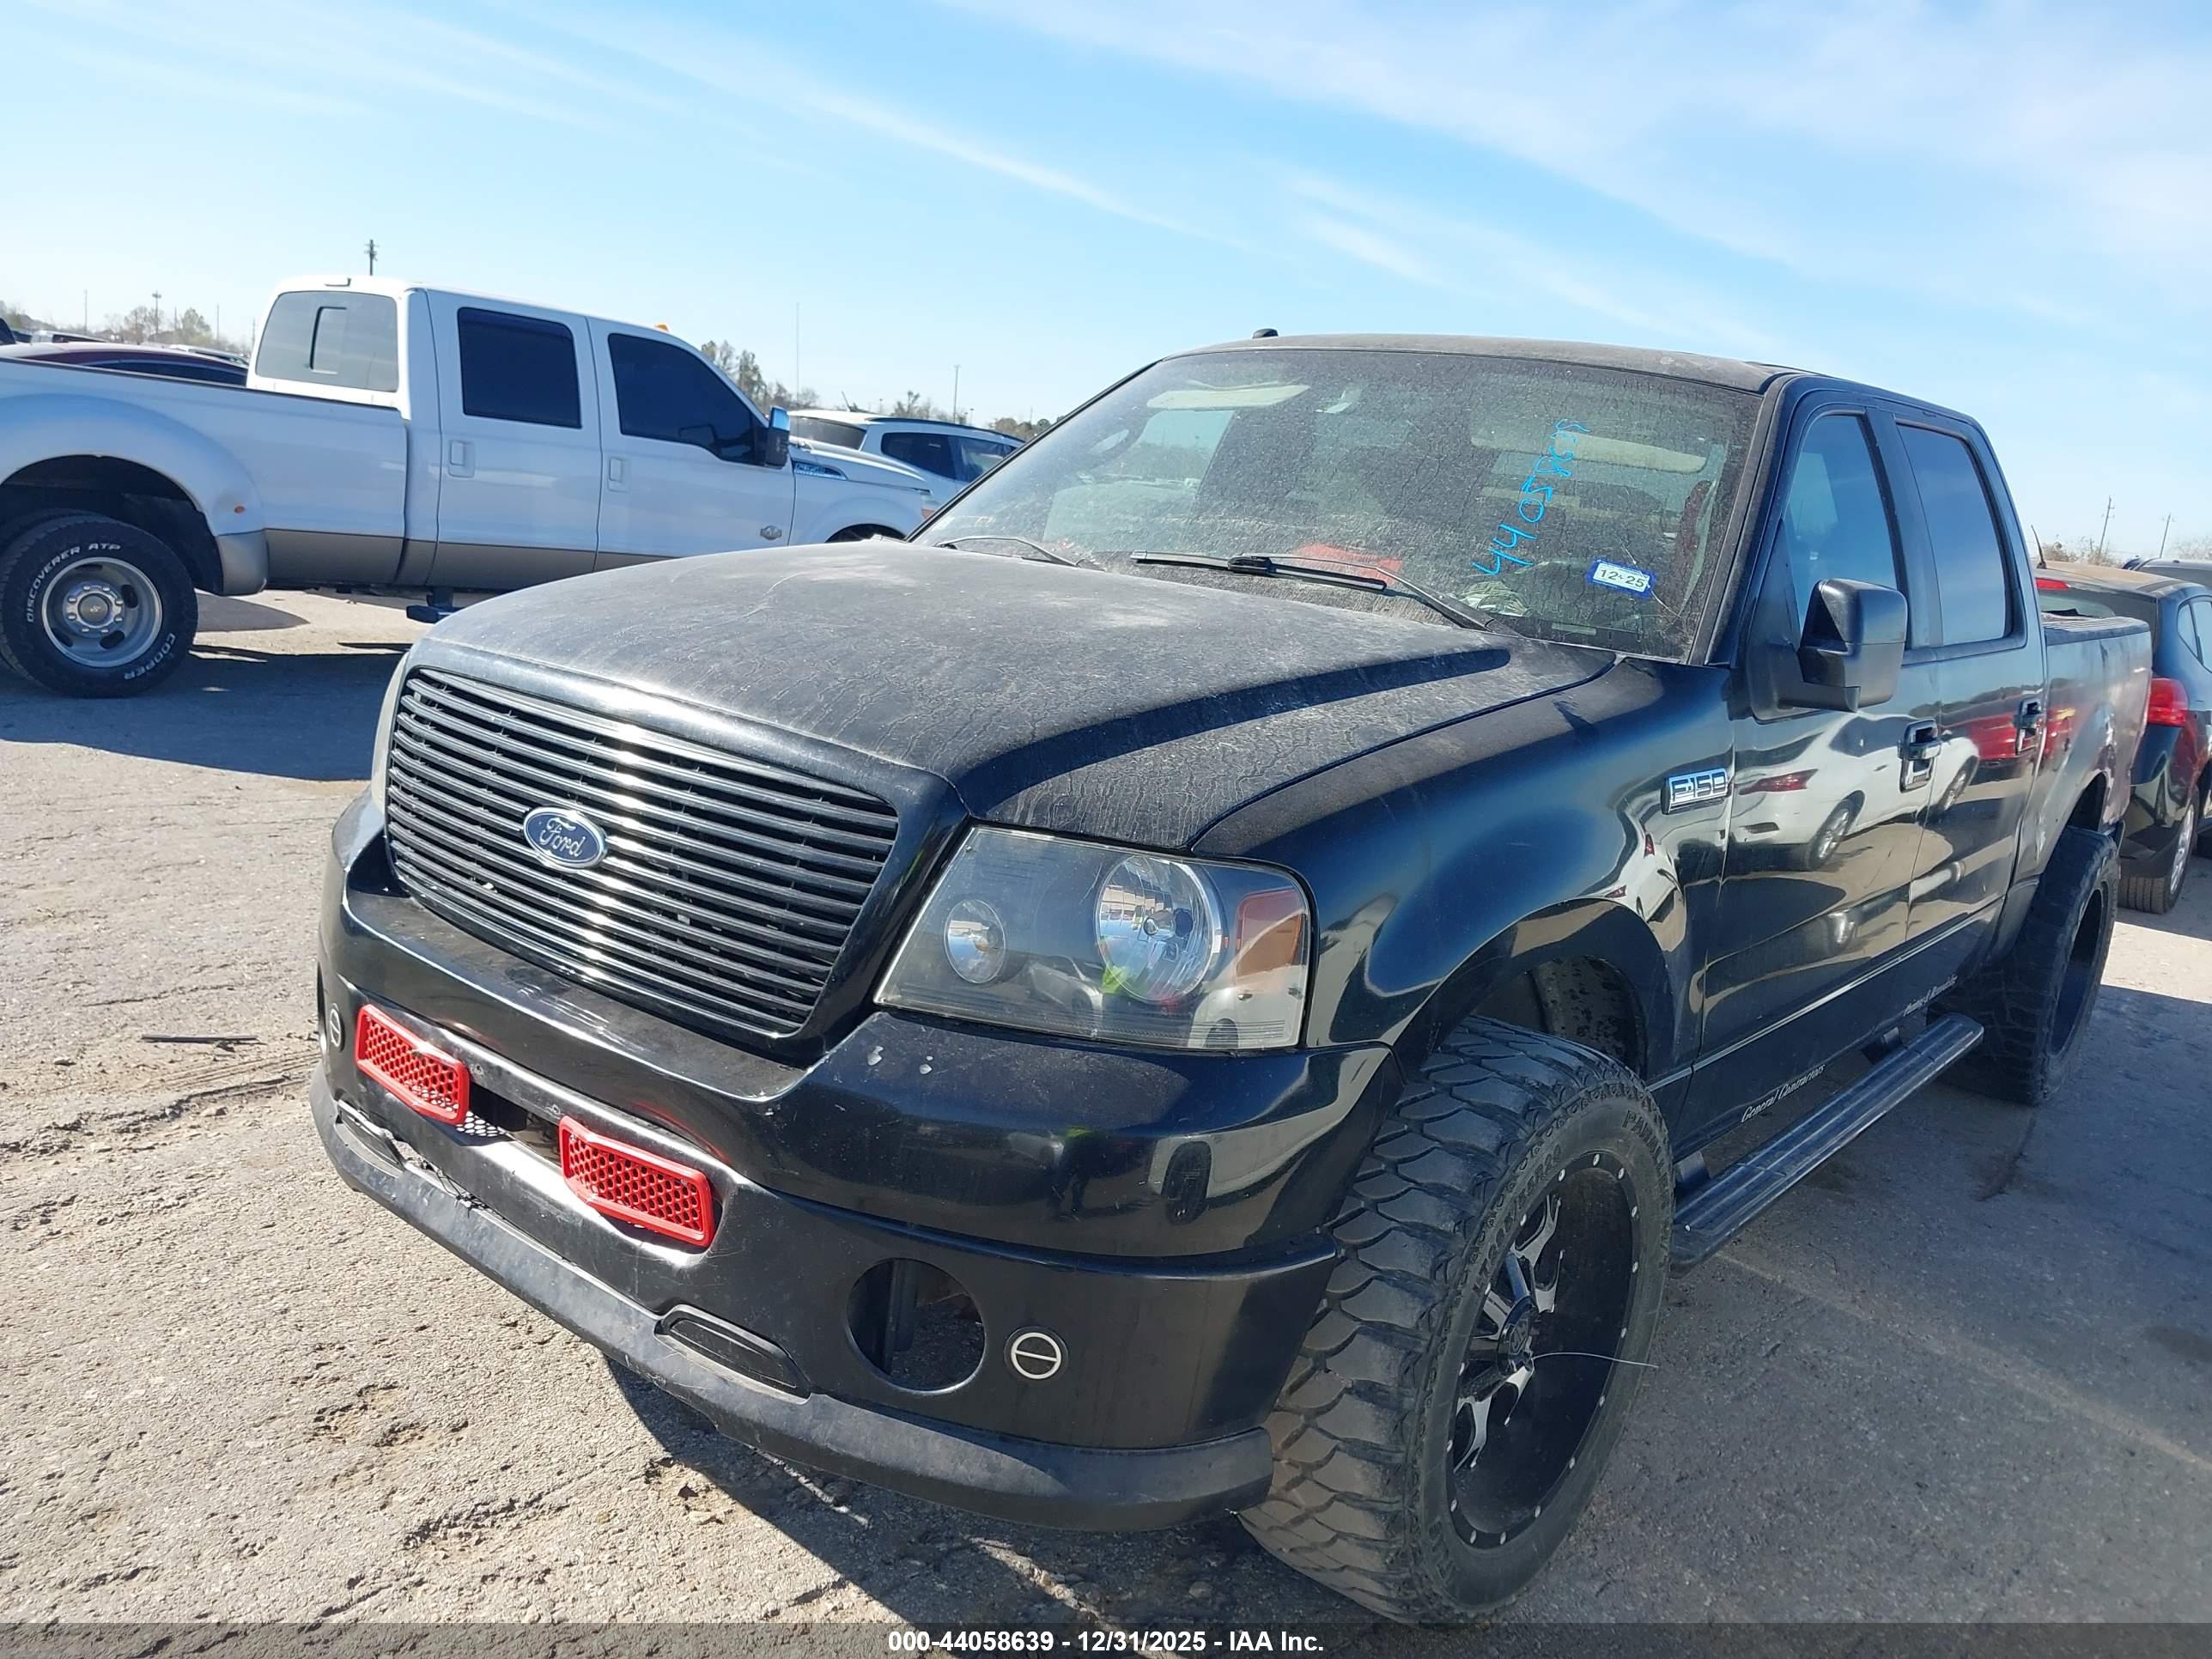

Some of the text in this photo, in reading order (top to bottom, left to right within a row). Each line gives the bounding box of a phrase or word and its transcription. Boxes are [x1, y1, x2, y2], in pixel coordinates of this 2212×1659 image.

[27, 542, 122, 623] DISCOVERER ATP
[125, 633, 175, 680] COOPER
[539, 817, 586, 857] Ford
